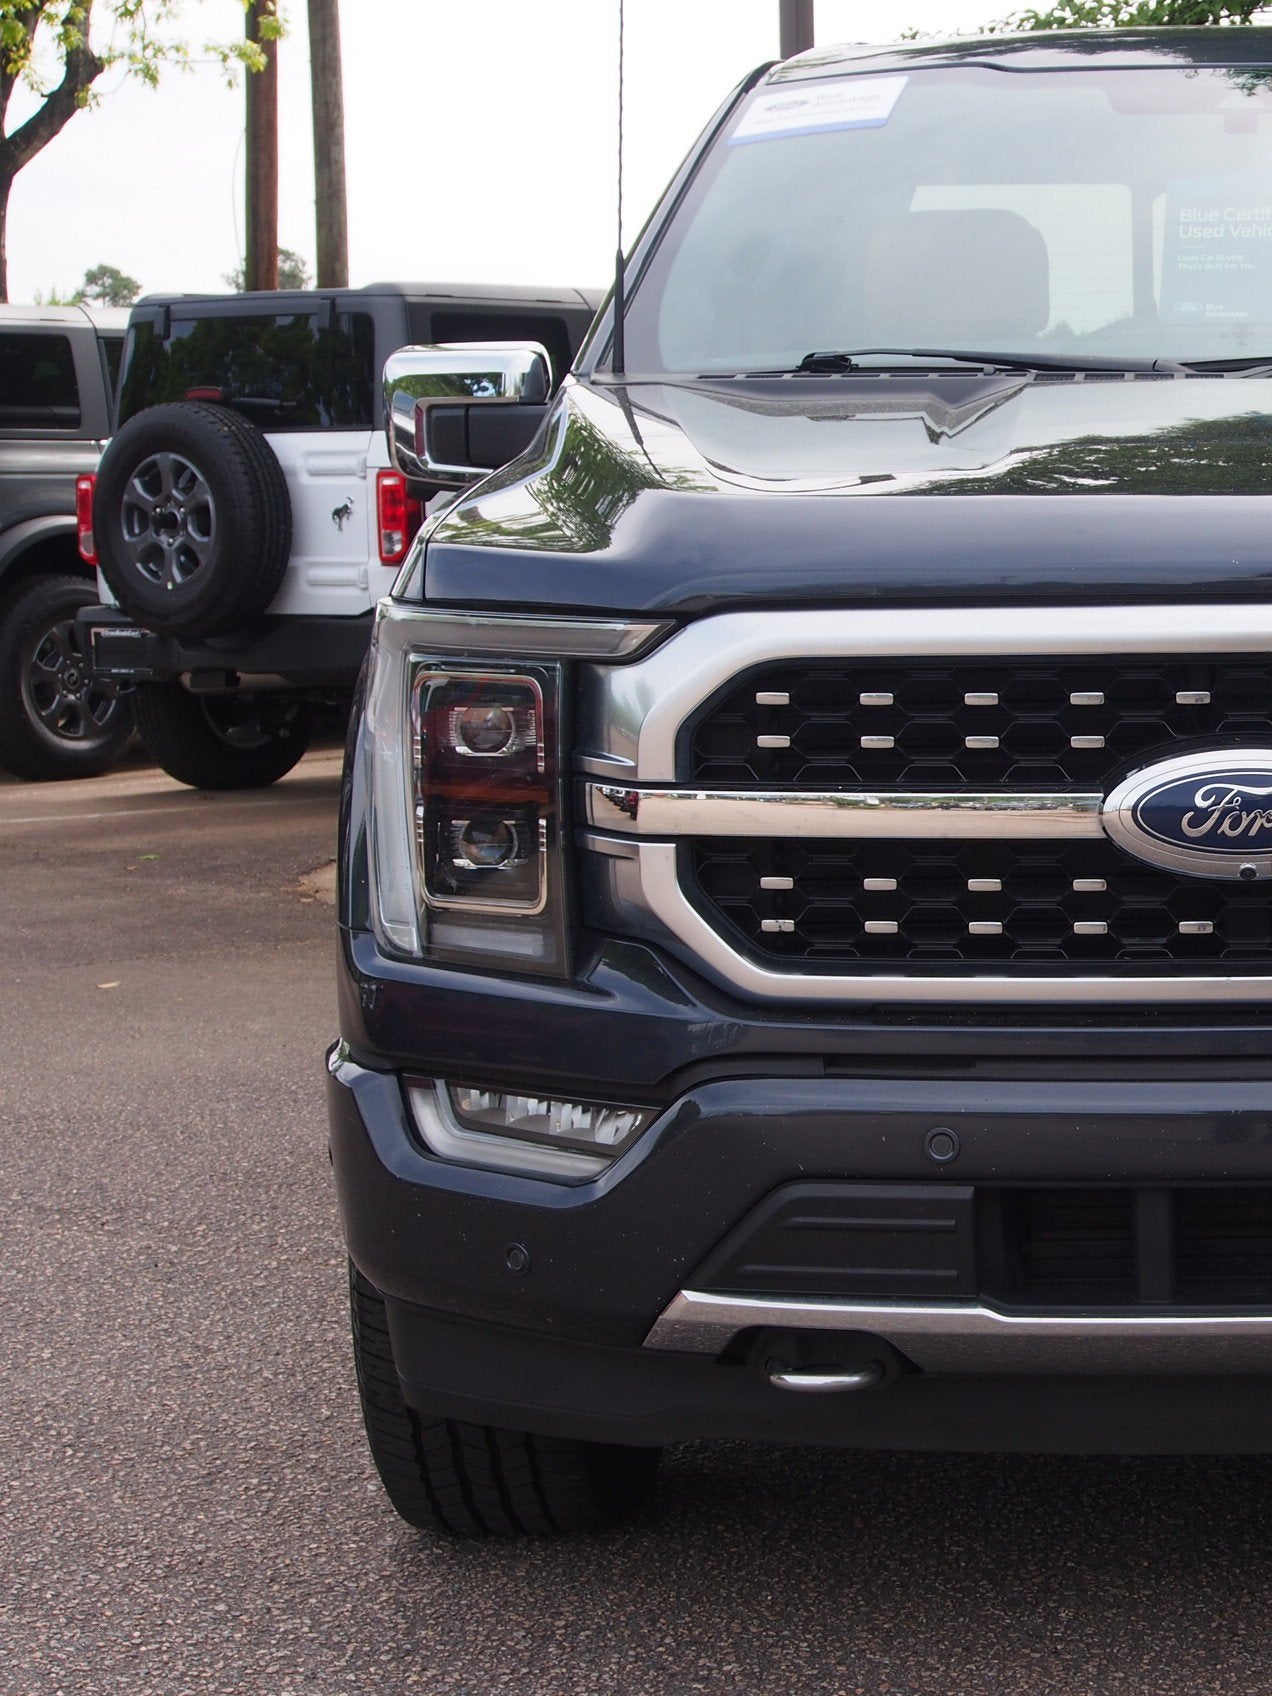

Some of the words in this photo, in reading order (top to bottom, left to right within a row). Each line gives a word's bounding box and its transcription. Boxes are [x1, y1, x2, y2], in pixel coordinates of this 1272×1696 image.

[1179, 208, 1219, 222] Blue
[1179, 223, 1225, 238] Used
[1177, 254, 1199, 262] Used
[1200, 254, 1215, 262] Car
[1204, 262, 1222, 270] Built
[1224, 262, 1237, 270] For
[1205, 303, 1224, 311] Blue
[1204, 311, 1250, 319] Advantage
